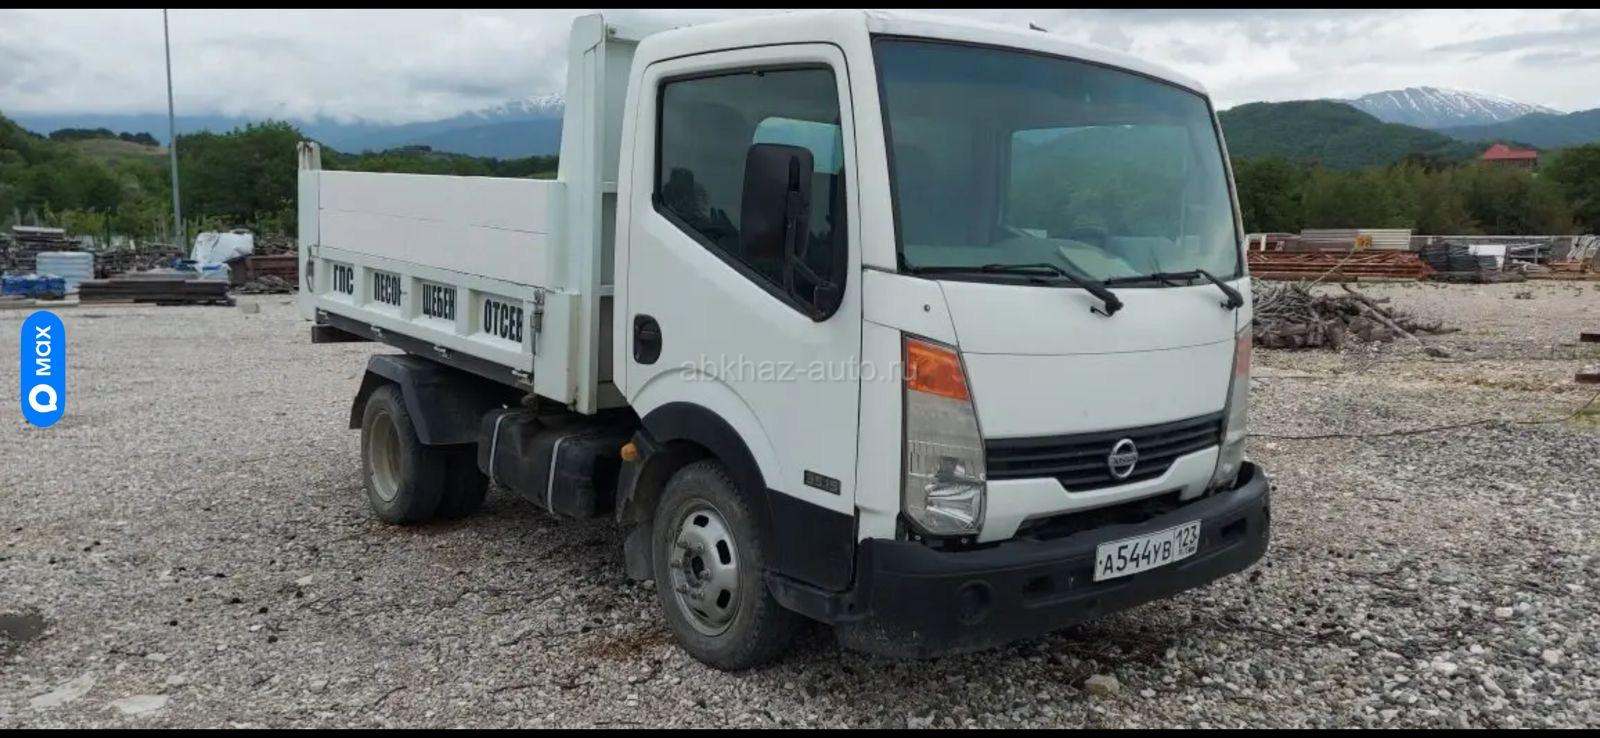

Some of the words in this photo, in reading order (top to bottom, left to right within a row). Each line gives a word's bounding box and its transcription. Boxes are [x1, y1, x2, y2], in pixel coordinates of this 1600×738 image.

[333, 264, 354, 295] ГПС
[484, 298, 524, 343] ОТСЕВ
[1175, 525, 1198, 549] 123
